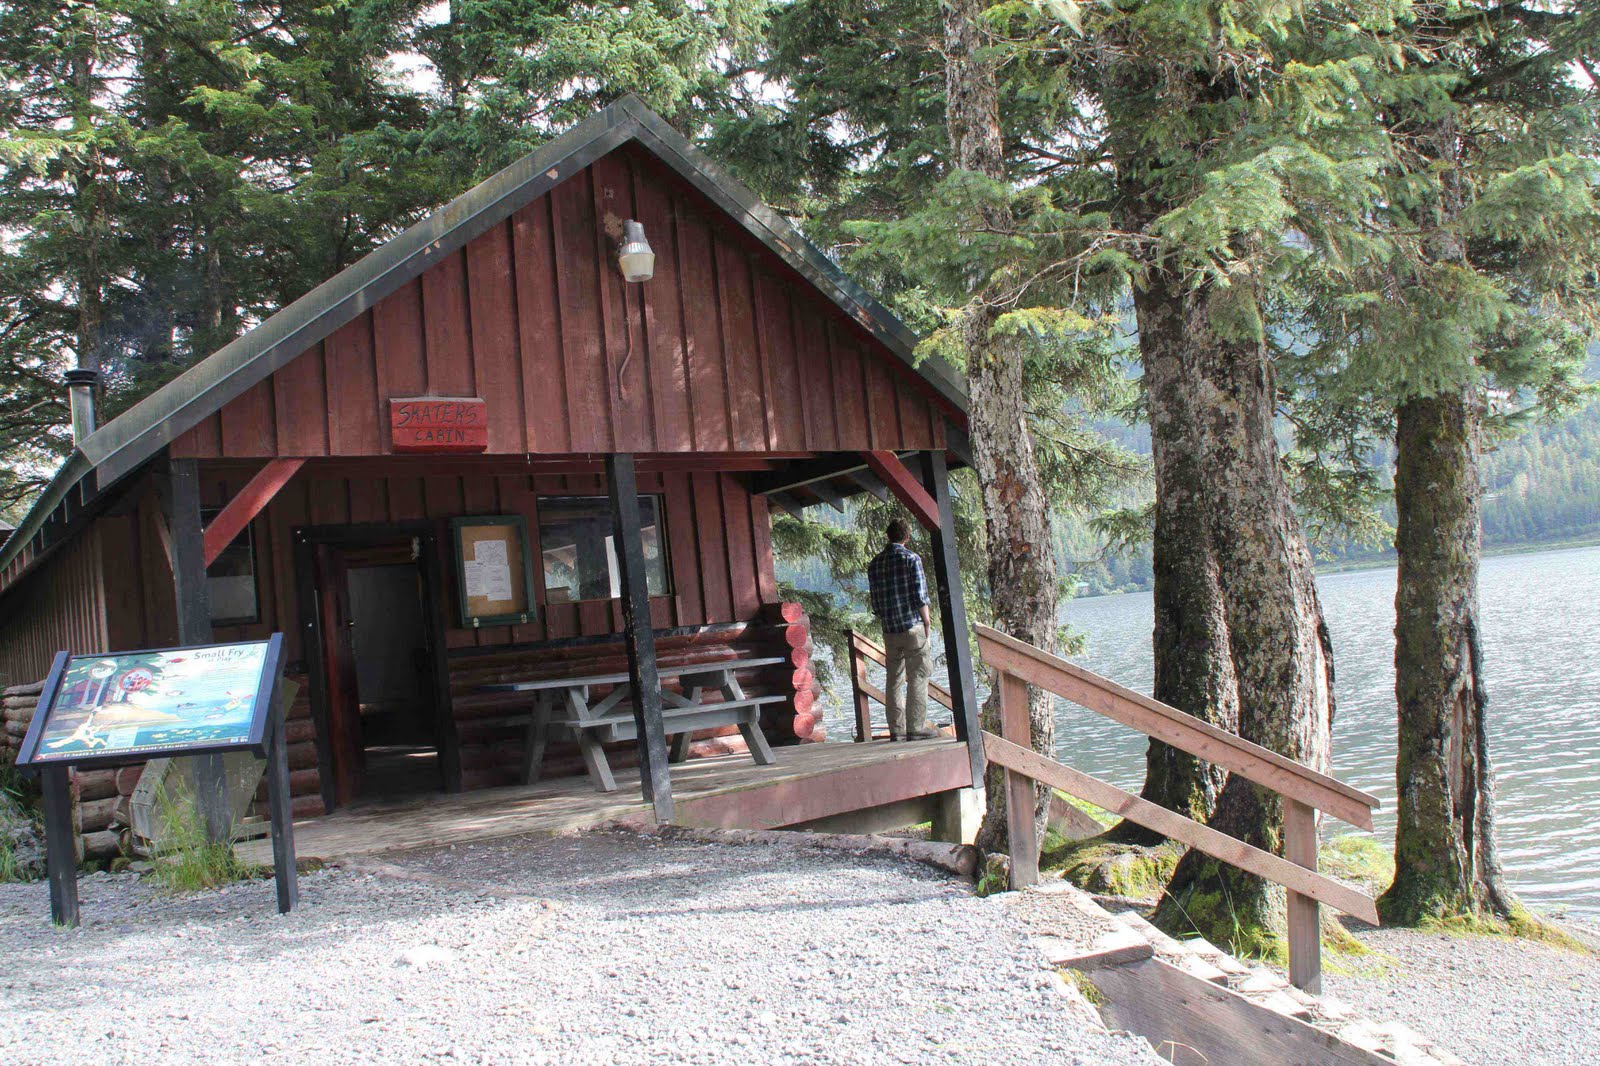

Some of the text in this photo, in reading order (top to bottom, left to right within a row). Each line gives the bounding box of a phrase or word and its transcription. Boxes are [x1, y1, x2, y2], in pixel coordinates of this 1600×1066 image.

[397, 403, 477, 425] SKATERS
[194, 648, 245, 660] Small Fry
